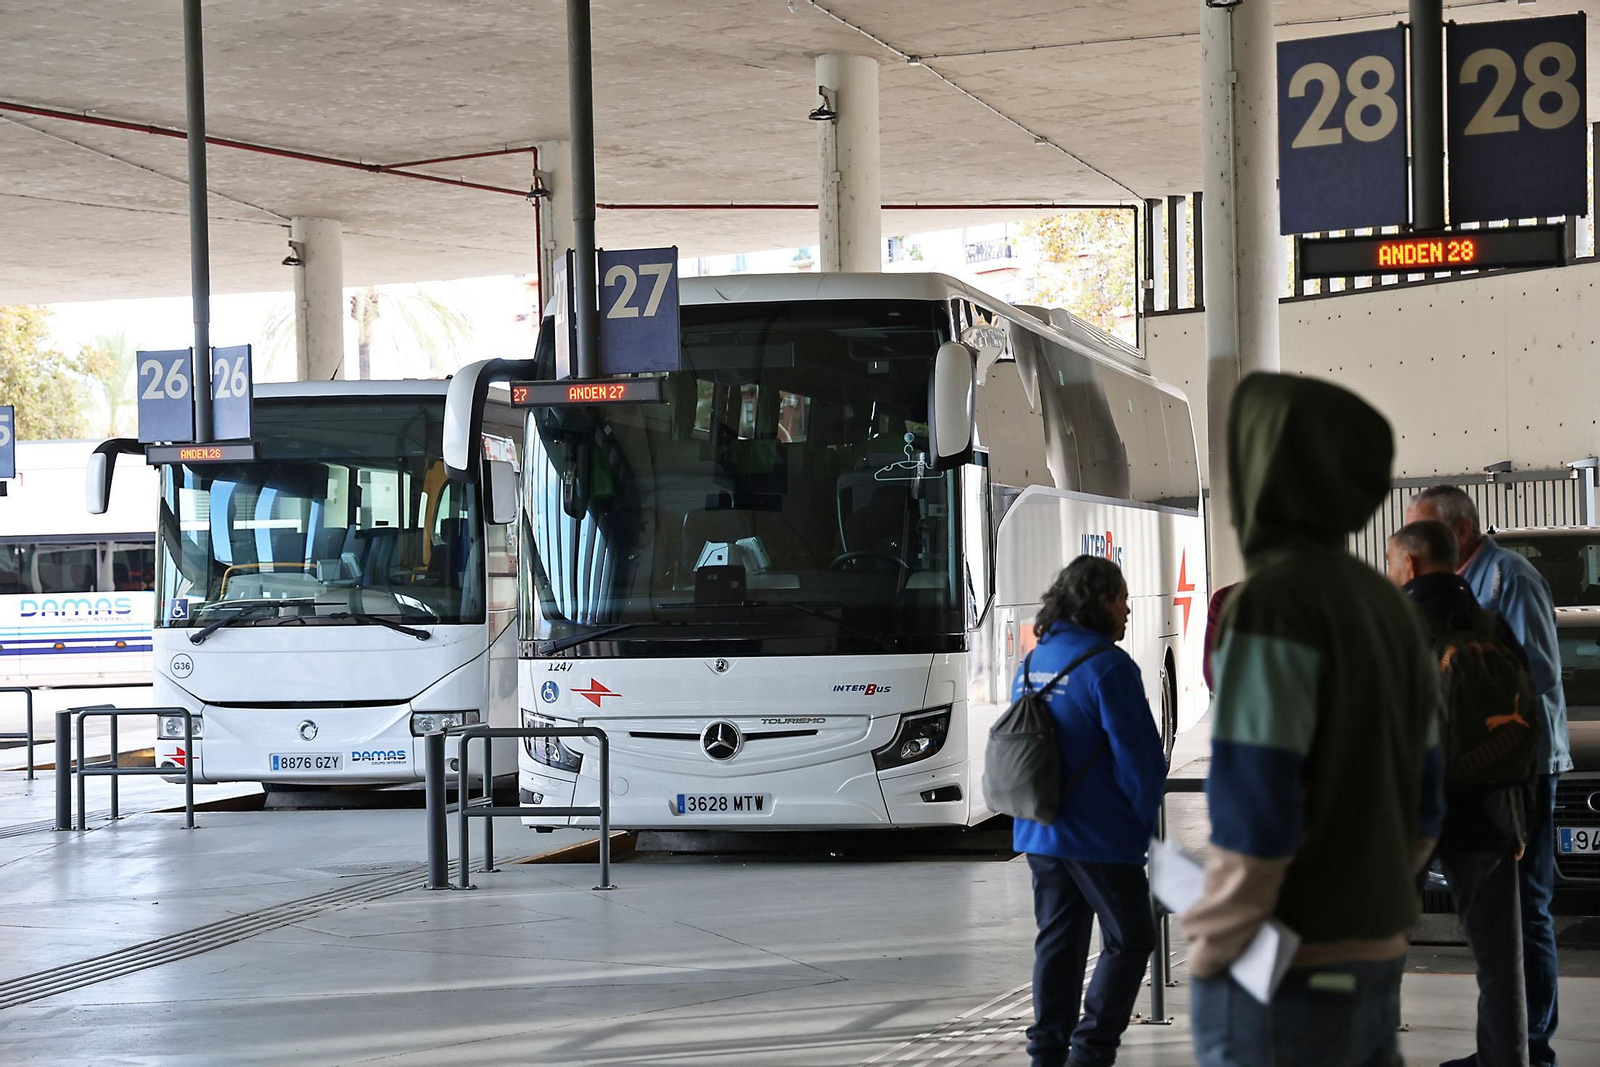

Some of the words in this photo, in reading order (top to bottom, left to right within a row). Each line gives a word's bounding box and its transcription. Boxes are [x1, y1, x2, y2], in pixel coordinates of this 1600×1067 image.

[1459, 41, 1581, 136] 28
[1288, 55, 1398, 149] 28
[1378, 243, 1443, 266] ANDEN
[1448, 240, 1475, 261] 28
[604, 263, 673, 319] 27
[140, 359, 189, 400] 26
[214, 357, 248, 399] 26
[513, 388, 527, 402] 27
[569, 386, 607, 400] ANDEN
[609, 385, 625, 398] 27
[20, 598, 131, 617] DAMAS
[173, 662, 190, 670] G36
[548, 661, 573, 672] 1247
[761, 717, 826, 725] TOURISMO
[281, 757, 312, 769] 8876
[315, 757, 339, 768] GZY
[351, 750, 406, 761] DAMAS
[687, 796, 728, 812] 3628
[733, 795, 764, 811] MTW
